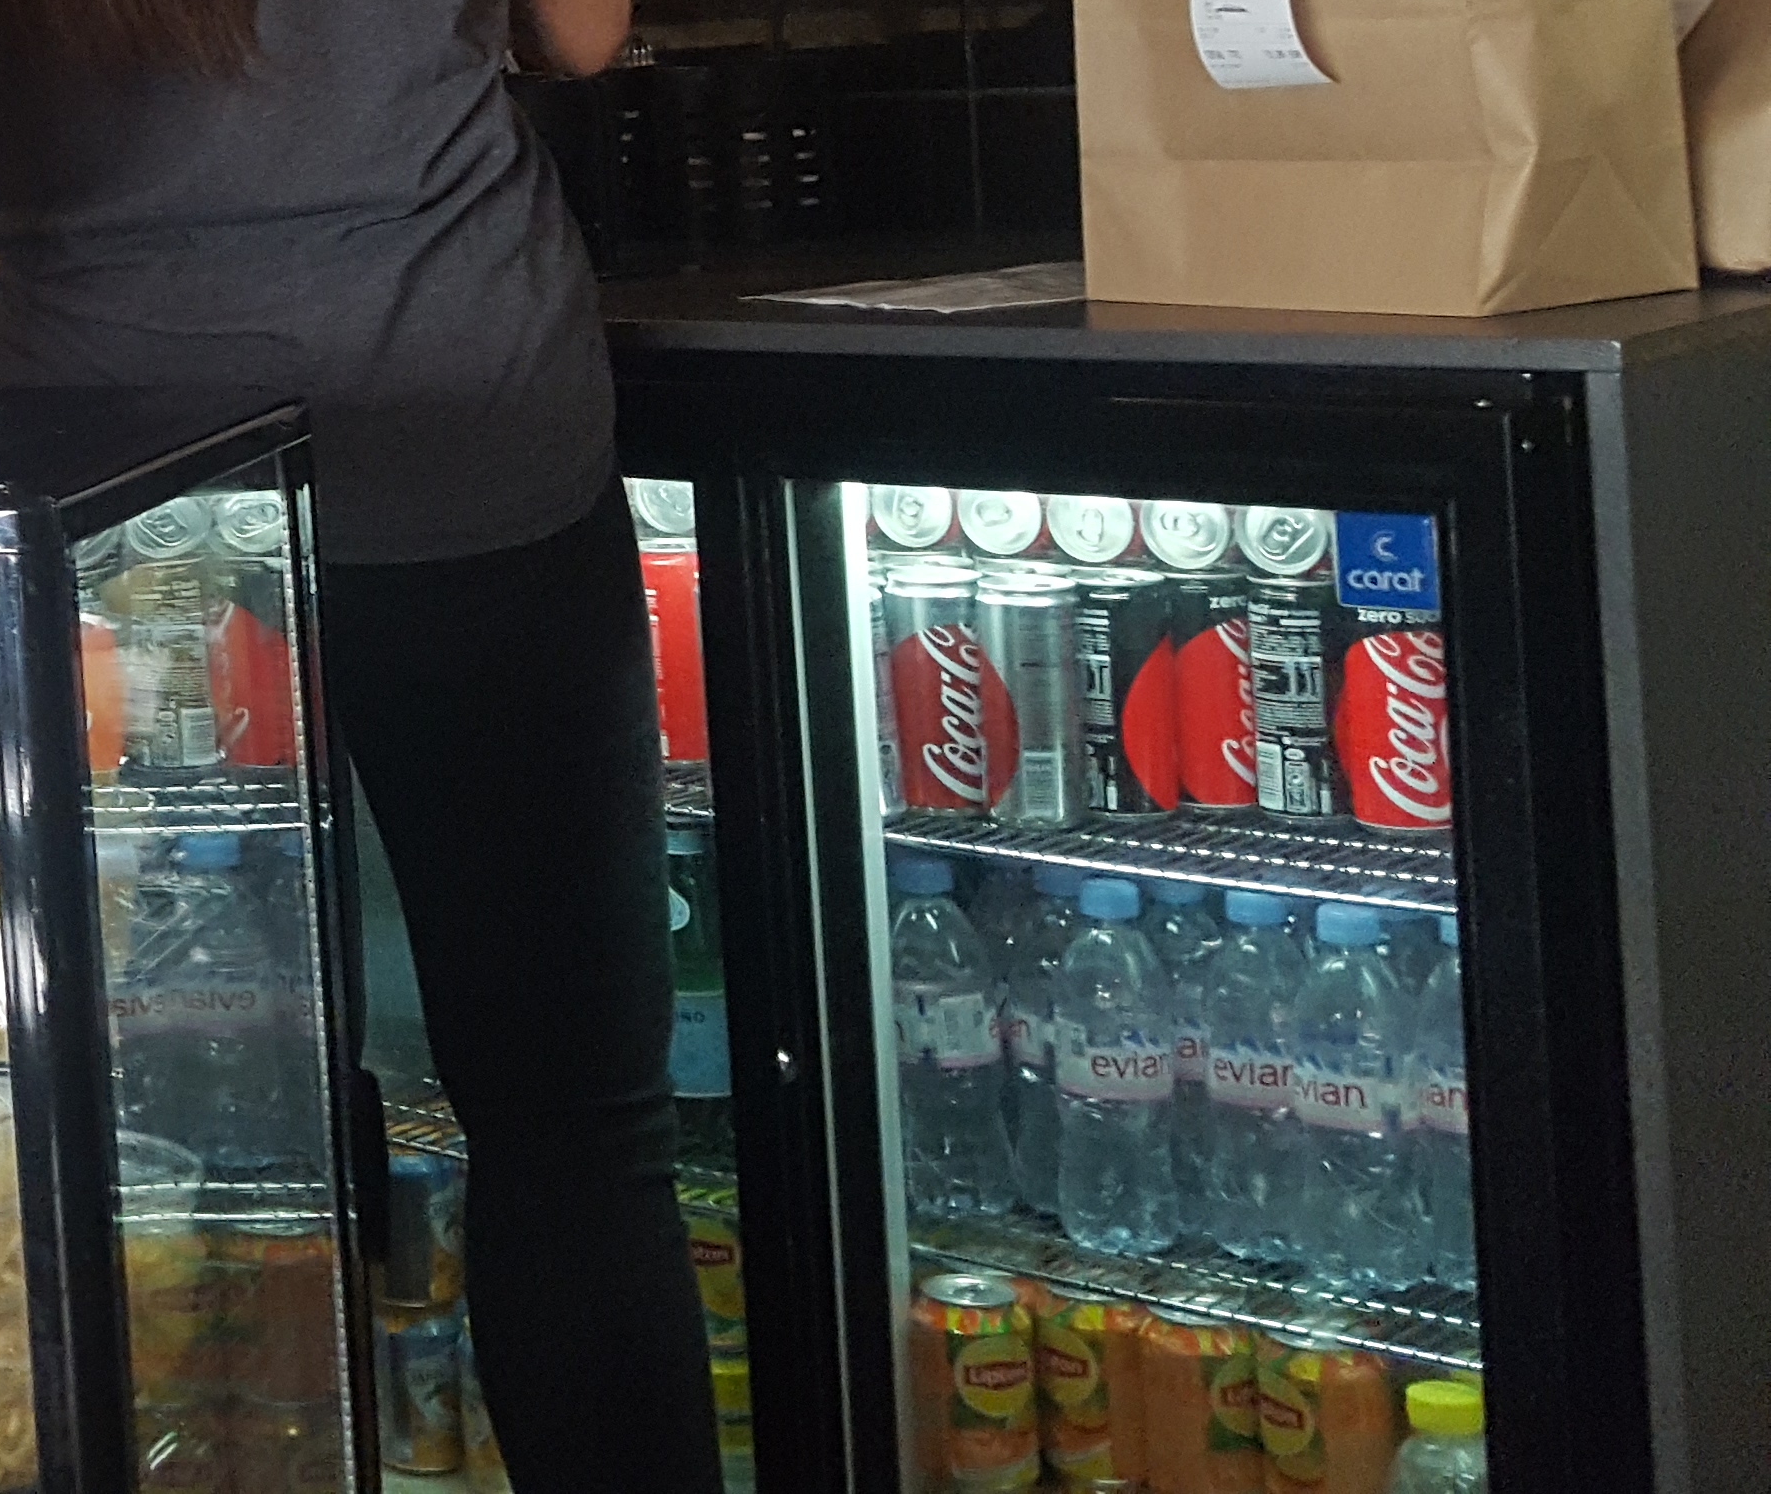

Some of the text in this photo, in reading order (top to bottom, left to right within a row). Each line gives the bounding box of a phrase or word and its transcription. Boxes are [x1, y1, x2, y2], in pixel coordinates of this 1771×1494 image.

[1346, 567, 1426, 594] carat
[1357, 607, 1403, 624] zero
[1297, 1077, 1368, 1109] vian
